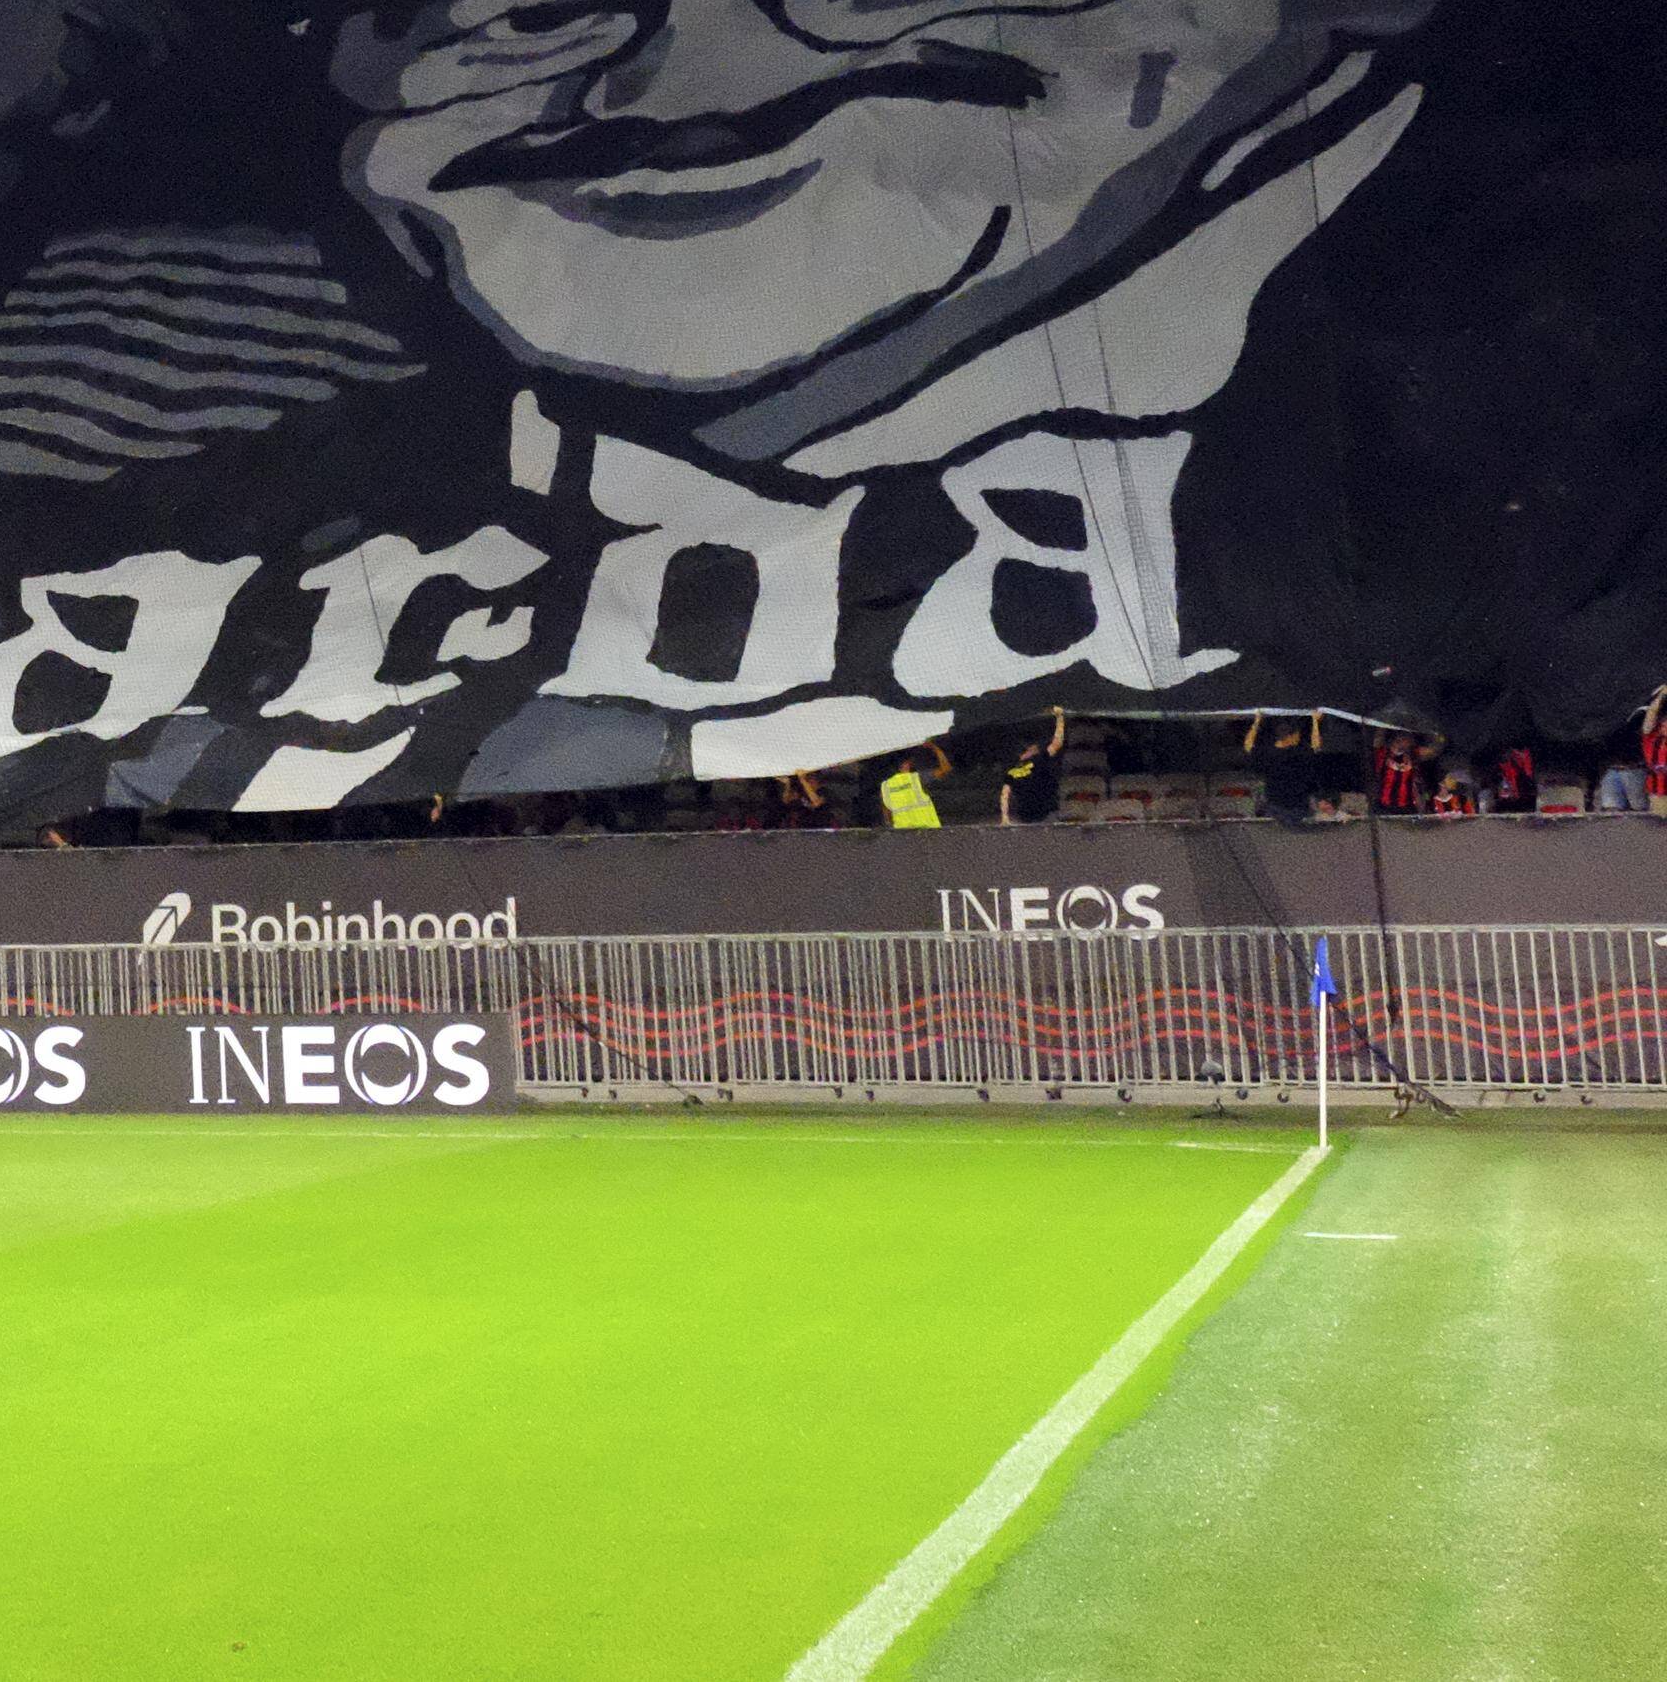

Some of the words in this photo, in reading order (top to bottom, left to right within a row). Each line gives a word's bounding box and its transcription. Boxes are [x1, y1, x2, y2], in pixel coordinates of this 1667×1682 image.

[211, 896, 518, 952] Robinhood
[936, 883, 1166, 942] INEOS
[187, 1023, 491, 1107] INEOS
